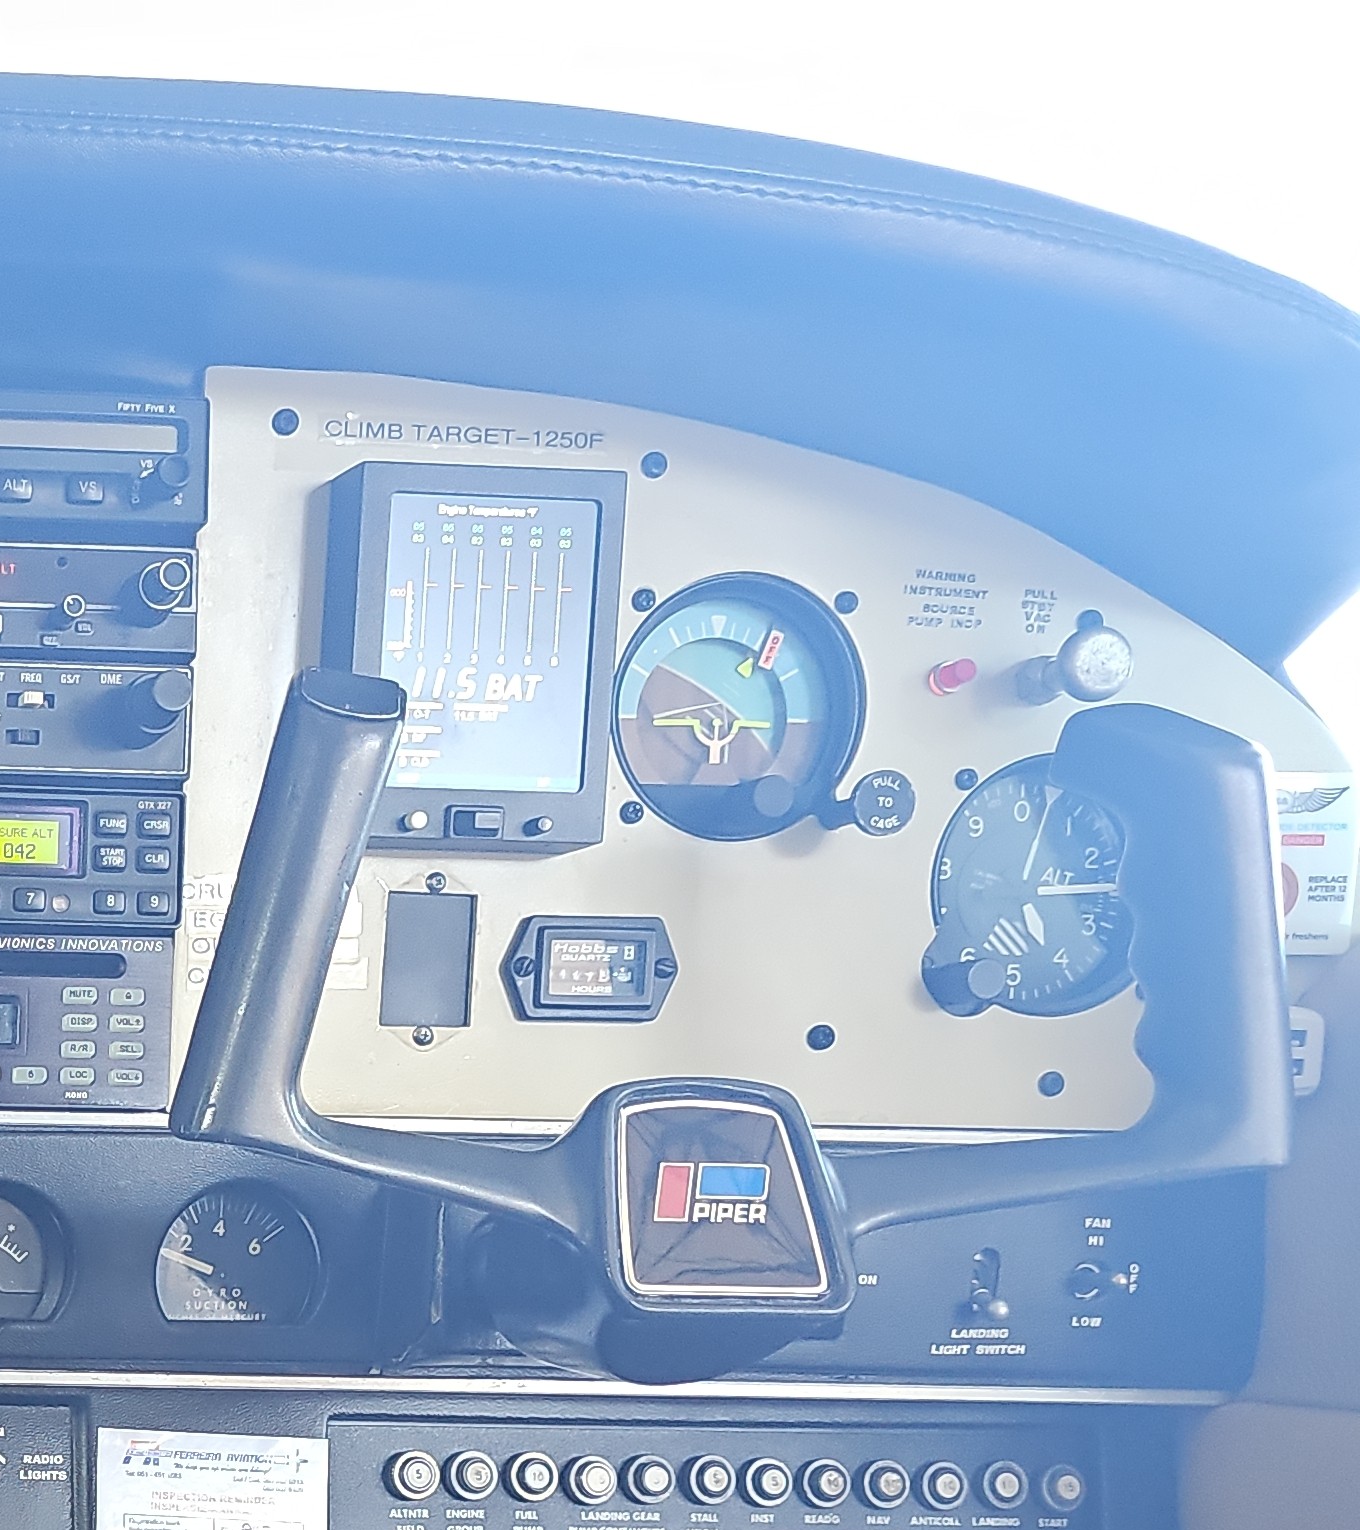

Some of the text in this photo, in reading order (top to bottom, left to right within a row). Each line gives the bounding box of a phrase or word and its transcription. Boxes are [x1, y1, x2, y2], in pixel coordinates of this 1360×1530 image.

[325, 420, 604, 449] CLIMB TARGET-1250F
[3, 478, 27, 492] ALT
[80, 481, 96, 493] VS
[916, 569, 976, 583] WARNING
[903, 585, 988, 599] INSTRUMENT
[29, 828, 52, 839] ALT
[3, 843, 36, 859] 042
[60, 938, 163, 952] INNOVATIONS
[554, 943, 618, 953] Hobbs
[693, 1203, 766, 1224] PIPER
[186, 1301, 248, 1310] SUCTION
[951, 1328, 1009, 1339] LANDING
[931, 1344, 1025, 1355] LIGHT SWITCH
[23, 1454, 63, 1465] RADIO
[20, 1470, 67, 1481] LIGHTS
[446, 1510, 484, 1519] ENGINE
[582, 1512, 660, 1521] LANDING GEAR
